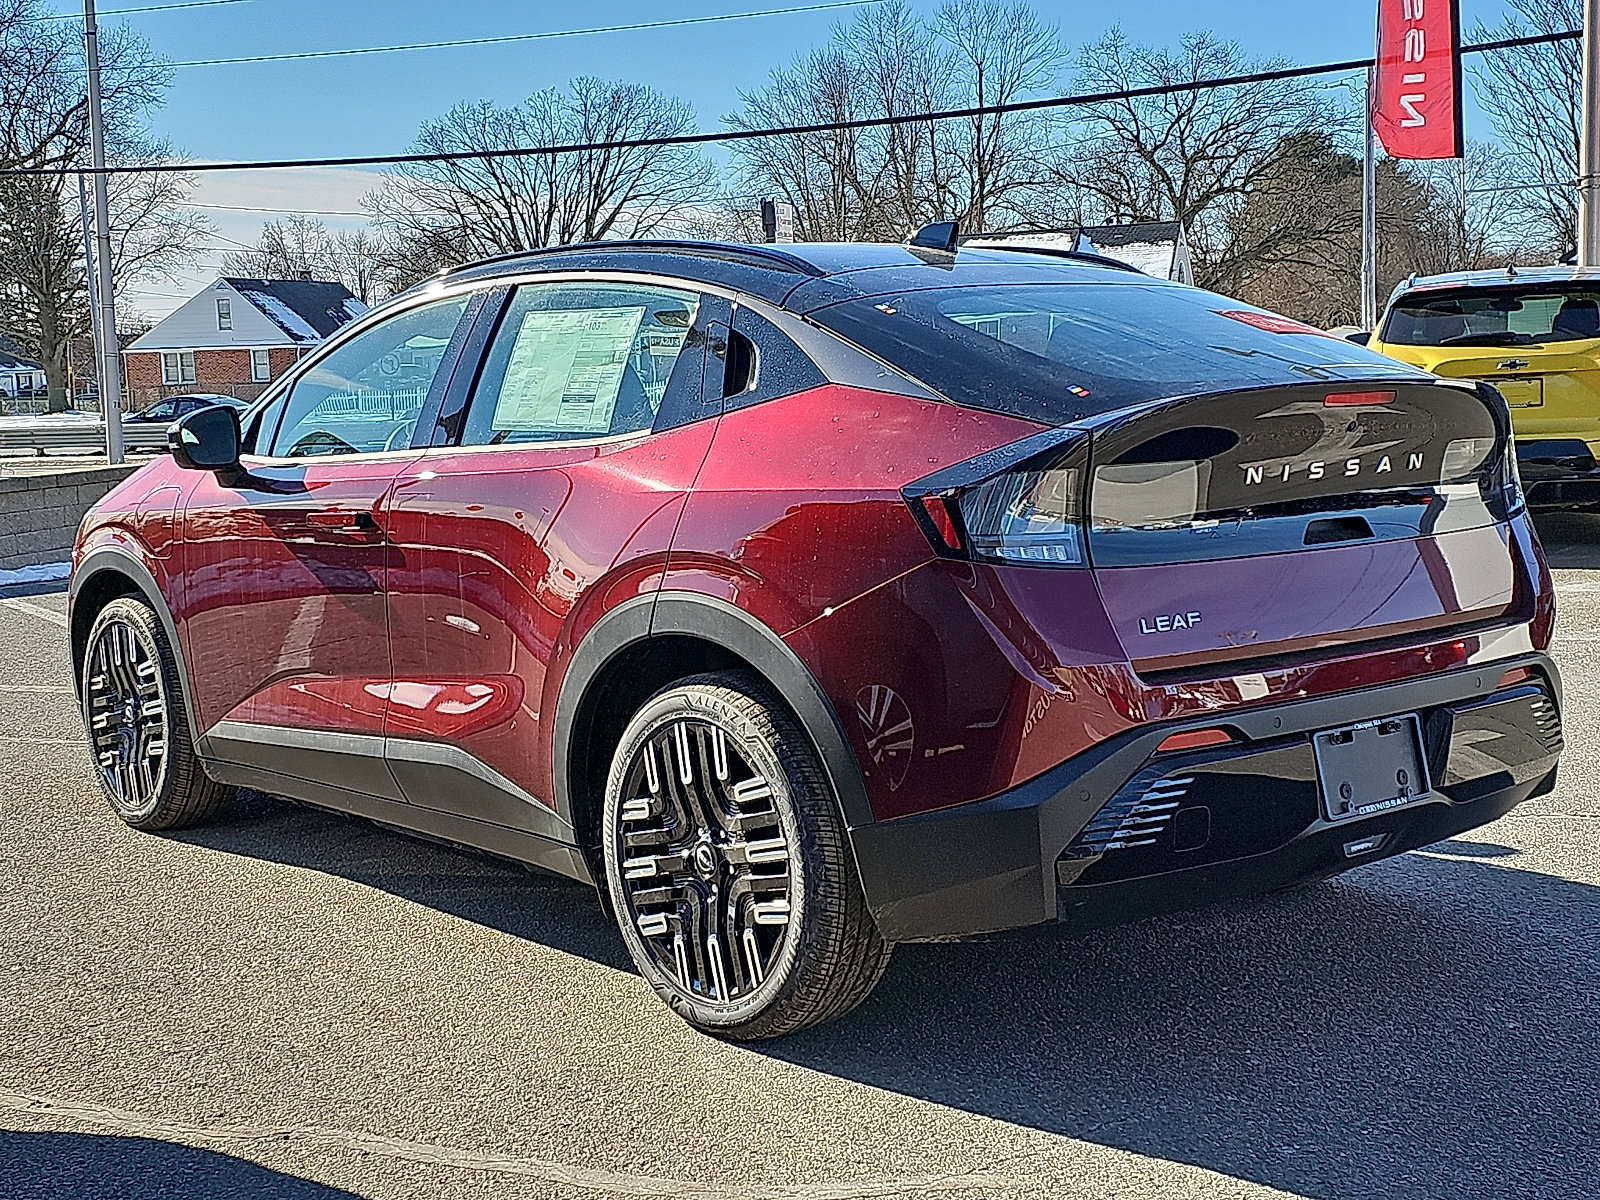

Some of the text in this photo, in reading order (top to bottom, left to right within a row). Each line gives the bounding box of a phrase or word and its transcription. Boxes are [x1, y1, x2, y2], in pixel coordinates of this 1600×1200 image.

[1243, 451, 1426, 486] NISSAN
[1138, 610, 1203, 635] LEAF
[694, 695, 747, 737] ALENZA
